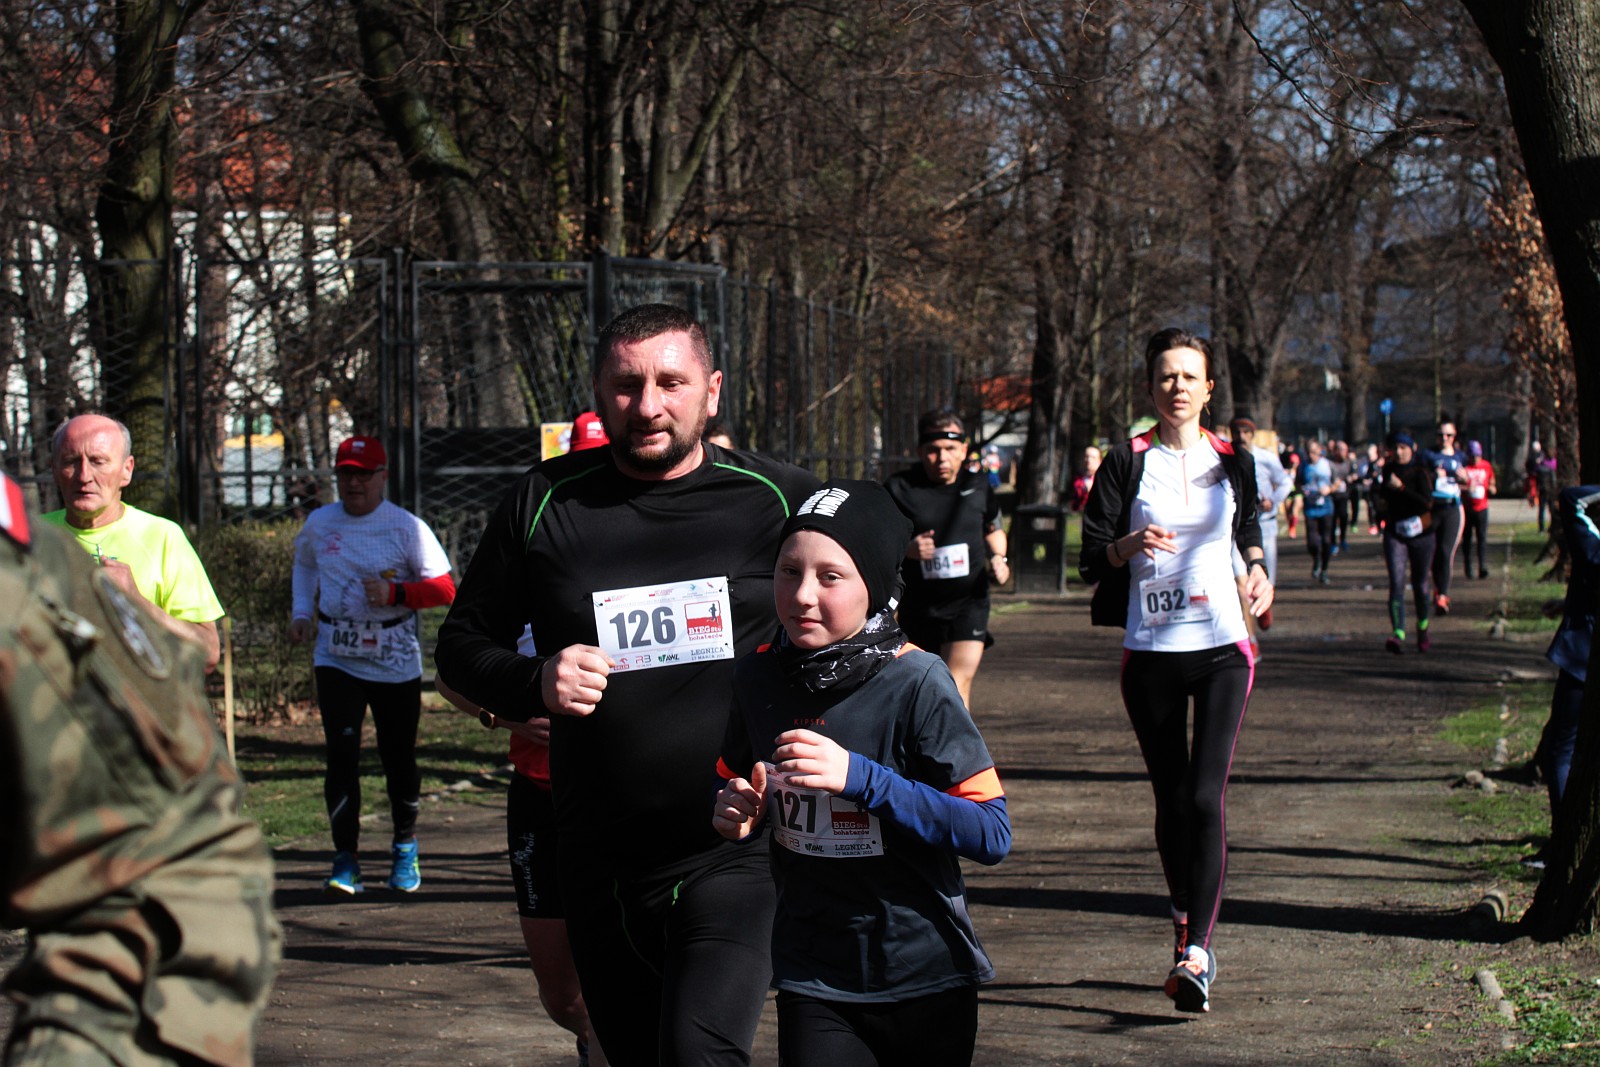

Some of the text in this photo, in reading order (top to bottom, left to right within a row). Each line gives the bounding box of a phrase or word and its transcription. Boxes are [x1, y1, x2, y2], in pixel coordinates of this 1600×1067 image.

[1146, 588, 1186, 614] 032
[609, 606, 676, 650] 126
[688, 625, 711, 635] BIEG
[332, 630, 359, 648] 042
[690, 647, 724, 656] LEGNICA
[773, 788, 817, 833] 127
[833, 821, 856, 829] BIEG
[834, 843, 872, 851] LEGNICA
